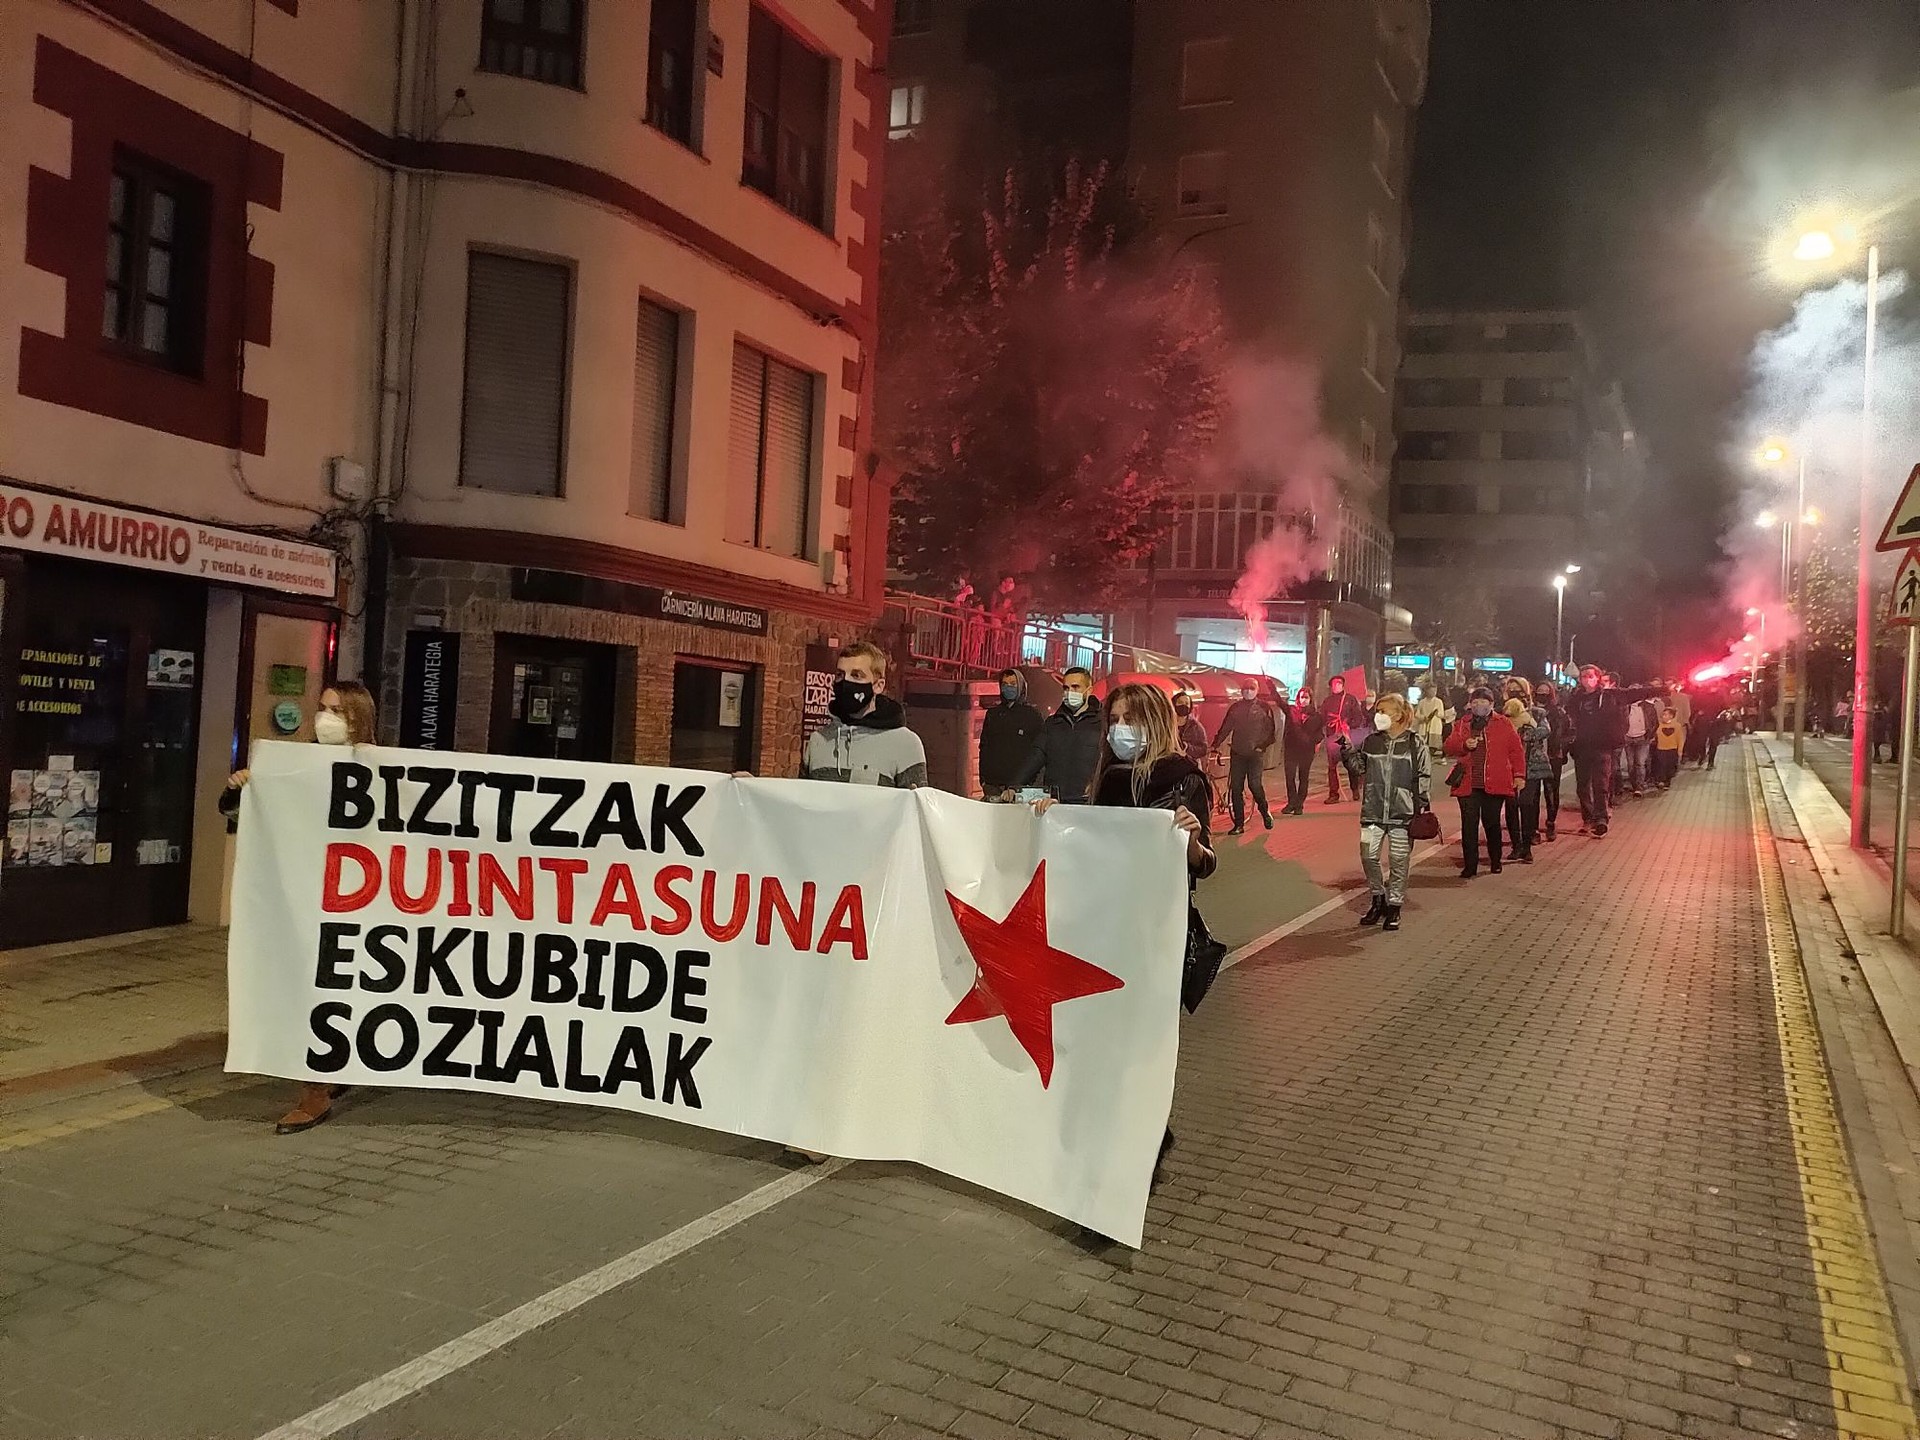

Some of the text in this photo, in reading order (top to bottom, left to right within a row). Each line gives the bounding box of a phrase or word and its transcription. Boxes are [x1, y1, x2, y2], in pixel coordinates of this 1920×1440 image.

[42, 503, 191, 565] AMURRIO
[197, 529, 268, 557] Reparación
[271, 544, 285, 560] de
[200, 559, 326, 589] y venta de accesorios
[704, 604, 726, 623] ALAVA
[726, 609, 762, 629] HARATEGIA
[21, 649, 84, 665] EPARACIONES
[423, 641, 443, 703] HARATEGIA
[20, 674, 96, 691] OVILES Y VENTA
[27, 700, 82, 715] ACCESORIOS
[420, 705, 439, 740] ALAVA
[327, 761, 707, 858] BIZITZAK
[321, 842, 869, 961] DUINTASUNA
[314, 922, 712, 1025] ESKUBIDE
[305, 1001, 714, 1110] SOZIALAK
